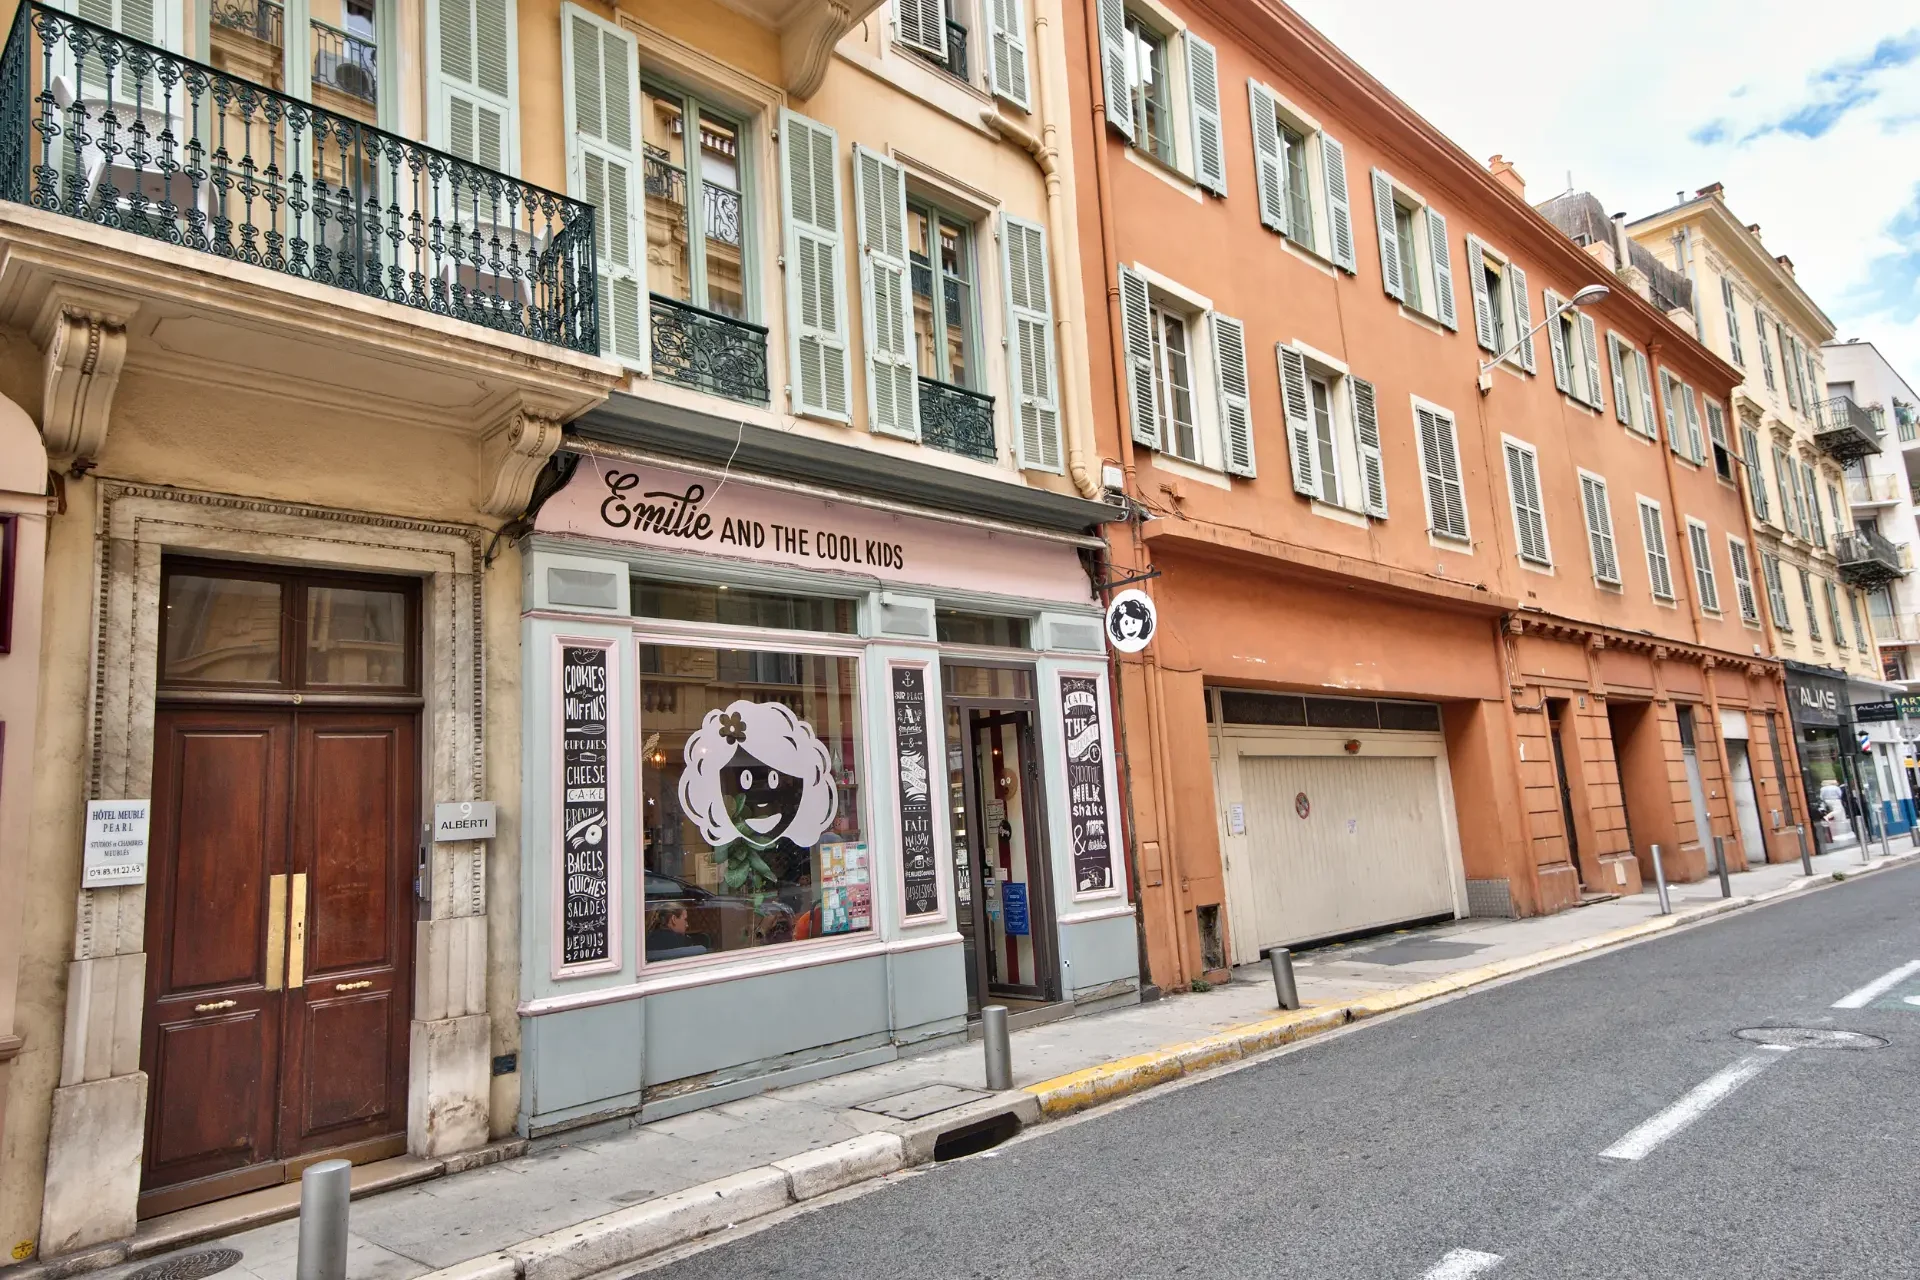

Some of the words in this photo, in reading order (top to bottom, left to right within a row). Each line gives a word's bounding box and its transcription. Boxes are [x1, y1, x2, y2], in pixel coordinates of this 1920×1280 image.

[600, 469, 713, 540] Emilie
[720, 516, 765, 549] AND
[771, 524, 810, 556] THE
[816, 531, 862, 563] COOL
[865, 540, 904, 569] KIDS
[565, 665, 605, 693] COOKIES
[894, 691, 906, 700] SUR
[1800, 686, 1836, 710] ALIAS
[566, 695, 606, 720] MUFFINS
[1858, 703, 1894, 711] ALIAS
[564, 740, 607, 750] CUPCAKES
[567, 766, 606, 785] CHEESE
[1072, 783, 1101, 803] MILK
[93, 809, 116, 820] HÔTEL
[118, 808, 145, 820] MEUBLÉ
[460, 802, 472, 819] 9
[1072, 802, 1104, 817] shake
[103, 823, 133, 832] PEARL
[441, 819, 488, 830] ALBERTI
[905, 816, 929, 831] FAIT
[905, 833, 929, 847] MAISON
[1074, 825, 1087, 855] &
[104, 849, 130, 857] MEUBLÉS
[567, 850, 604, 874] BAGELS
[568, 875, 607, 897] QUICHES
[568, 900, 607, 918] SALADES
[567, 933, 604, 951] DEPUIS
